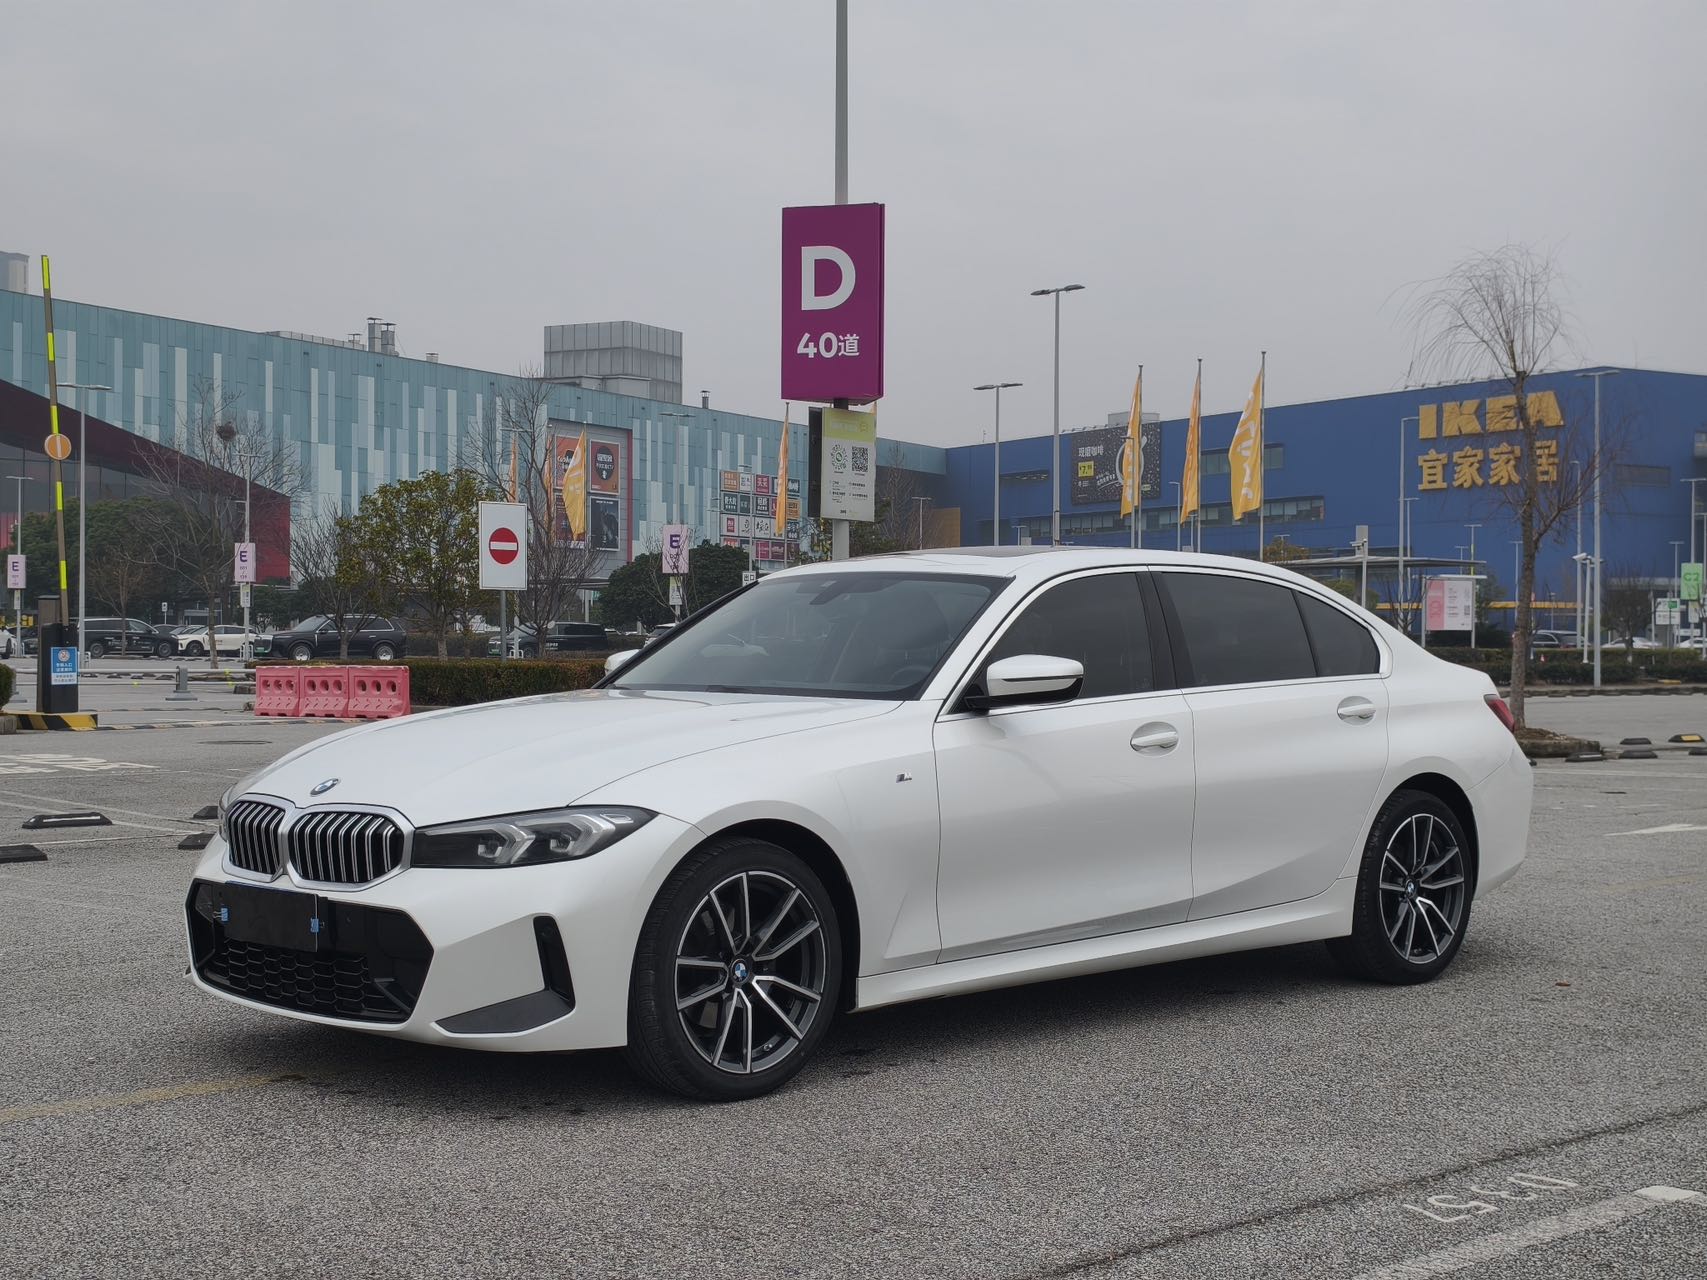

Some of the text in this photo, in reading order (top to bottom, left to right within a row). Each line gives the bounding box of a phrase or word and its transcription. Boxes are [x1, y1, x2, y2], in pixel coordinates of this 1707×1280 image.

[801, 245, 856, 311] D
[797, 332, 860, 358] 40道
[1418, 390, 1565, 440] IKEA
[1417, 440, 1560, 490] 宜家家居
[670, 534, 681, 549] E
[239, 550, 248, 562] E
[11, 561, 20, 572] E
[744, 573, 755, 582] 出口
